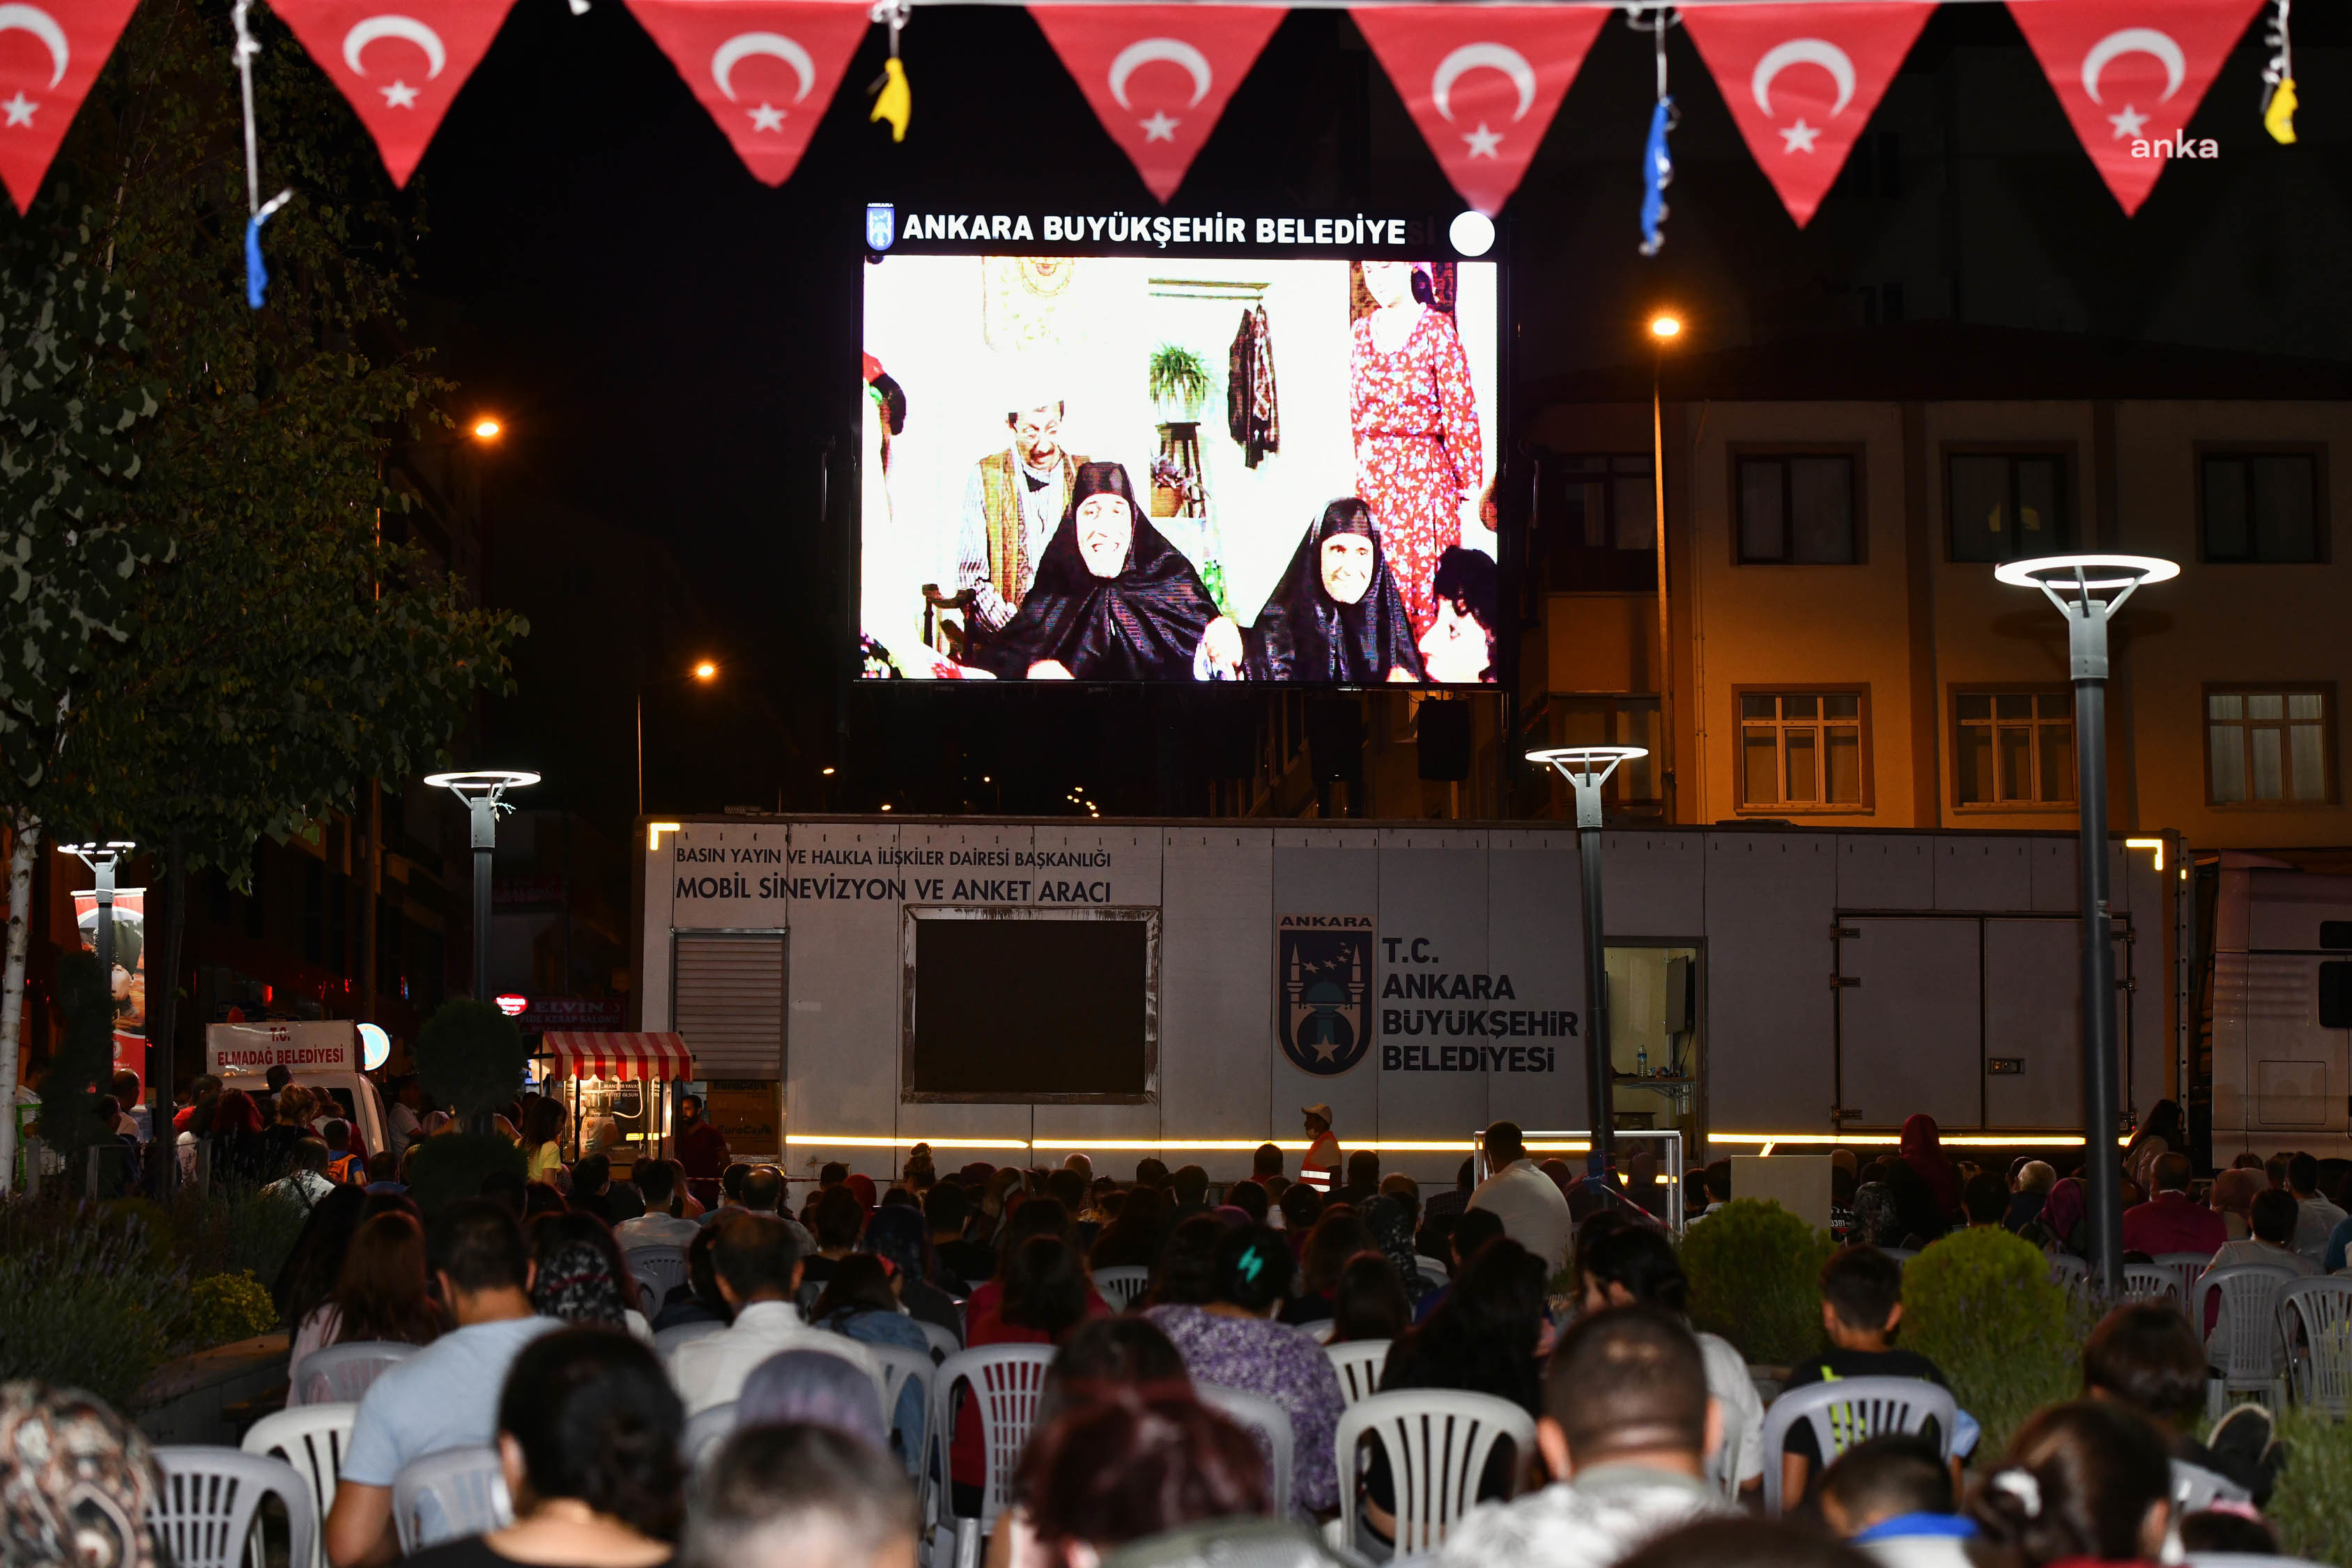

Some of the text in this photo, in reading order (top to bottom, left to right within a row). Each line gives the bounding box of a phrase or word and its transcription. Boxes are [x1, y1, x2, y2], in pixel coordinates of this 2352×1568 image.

[902, 214, 1034, 240] ANKARA
[677, 846, 1111, 870] BASIN YAYIN VE HALKLA İLİŞKİLER DAİRESİ BAŞKANLIĞI
[676, 871, 1110, 903] MOBİL SİNEVİZYON VE ANKET ARACI
[1280, 916, 1372, 928] ANKARA
[1382, 937, 1439, 964] T.C.
[1381, 972, 1516, 1000] ANKARA
[270, 1027, 291, 1042] T.C.
[1383, 1008, 1578, 1040] BÜYÜKŞEHİR
[217, 1043, 344, 1066] ELMADAĞ BELEDİYESİ
[1383, 1045, 1555, 1073] BELEDİYESİ
